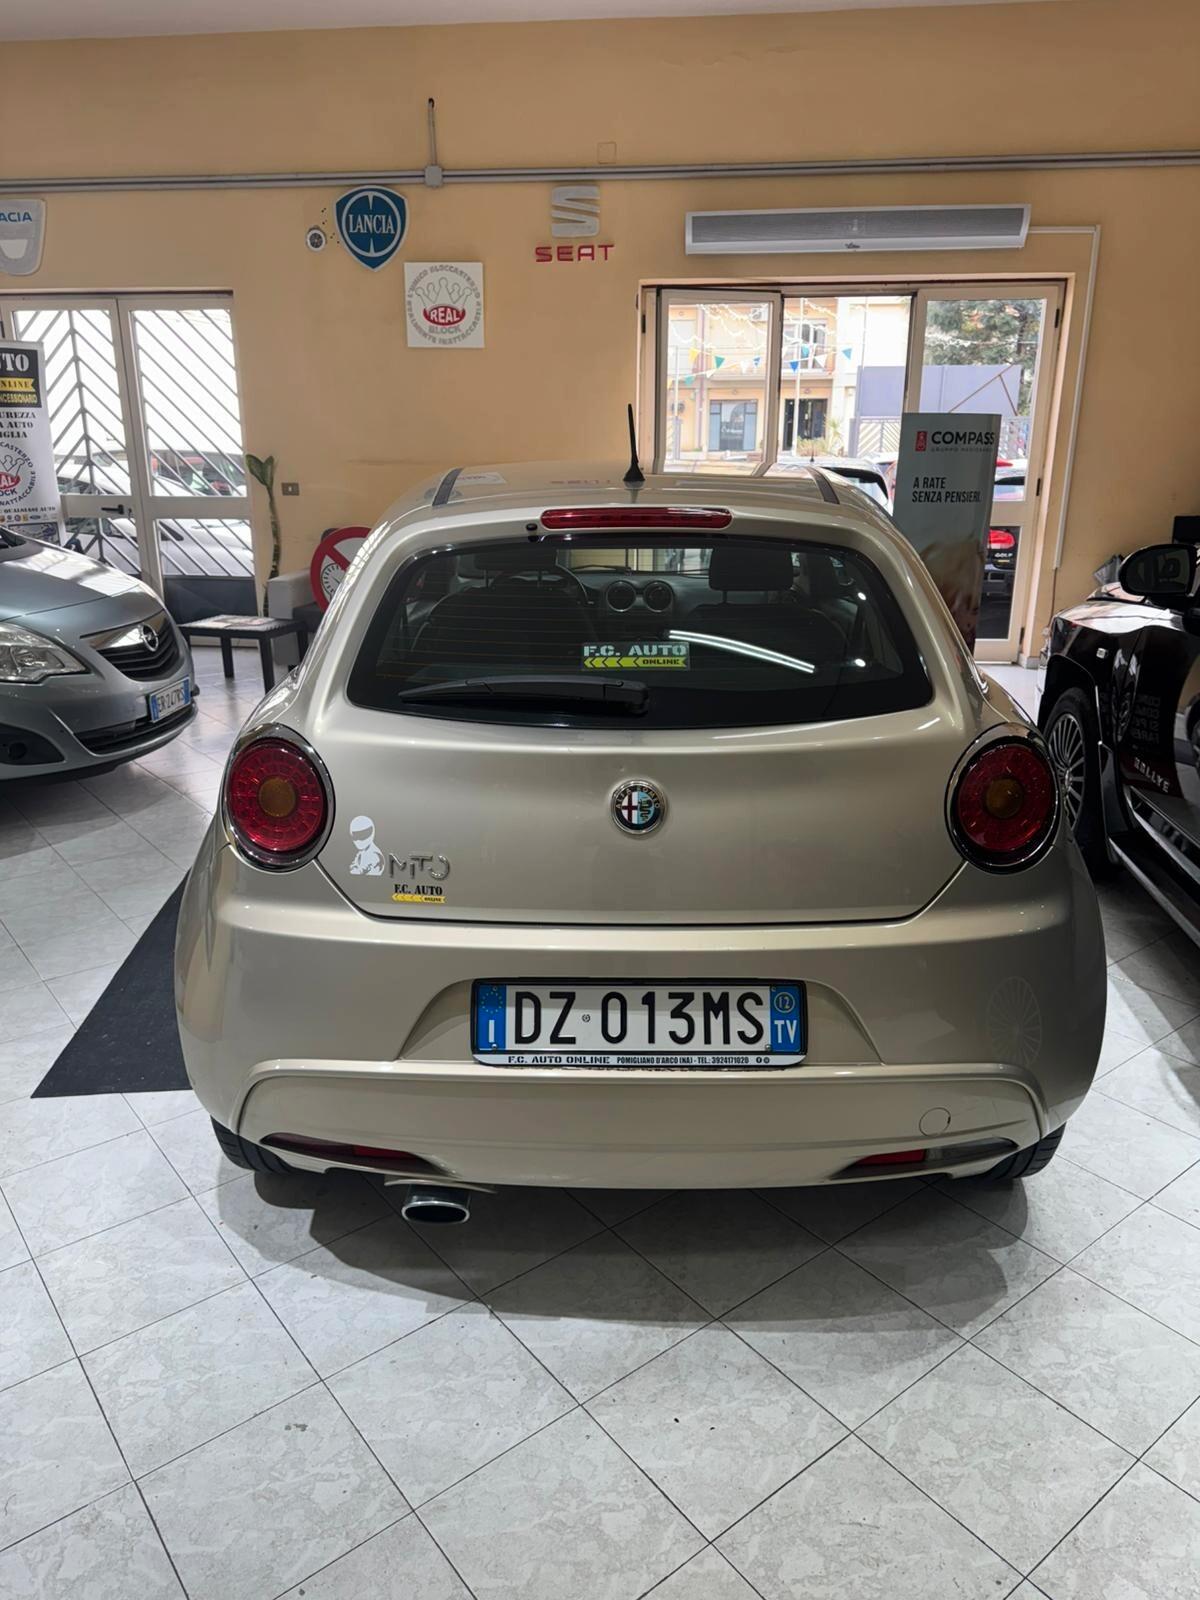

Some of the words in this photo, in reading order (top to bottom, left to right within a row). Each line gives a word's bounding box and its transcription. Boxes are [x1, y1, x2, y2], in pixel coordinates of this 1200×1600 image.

[348, 213, 396, 235] LANCIA
[535, 244, 615, 263] SEAT
[430, 307, 461, 323] REAL
[429, 326, 462, 335] BLOCK
[931, 430, 996, 446] COMPASS
[913, 477, 920, 489] A
[922, 477, 947, 489] RATE
[912, 491, 942, 503] SENZA
[944, 491, 982, 503] PENSIERI
[583, 645, 621, 657] F.C.
[628, 644, 688, 656] AUTO
[414, 884, 443, 896] AUTO
[778, 996, 790, 1009] 12
[489, 1019, 495, 1043] I
[514, 991, 577, 1045] DZ
[601, 991, 764, 1045] 013MS
[774, 1019, 797, 1044] TV
[507, 1055, 528, 1064] F.C.
[531, 1055, 562, 1064] AUTO
[565, 1055, 610, 1064] ONLINE
[616, 1056, 655, 1064] POMIGLIANO
[656, 1056, 678, 1064] D'ARCO
